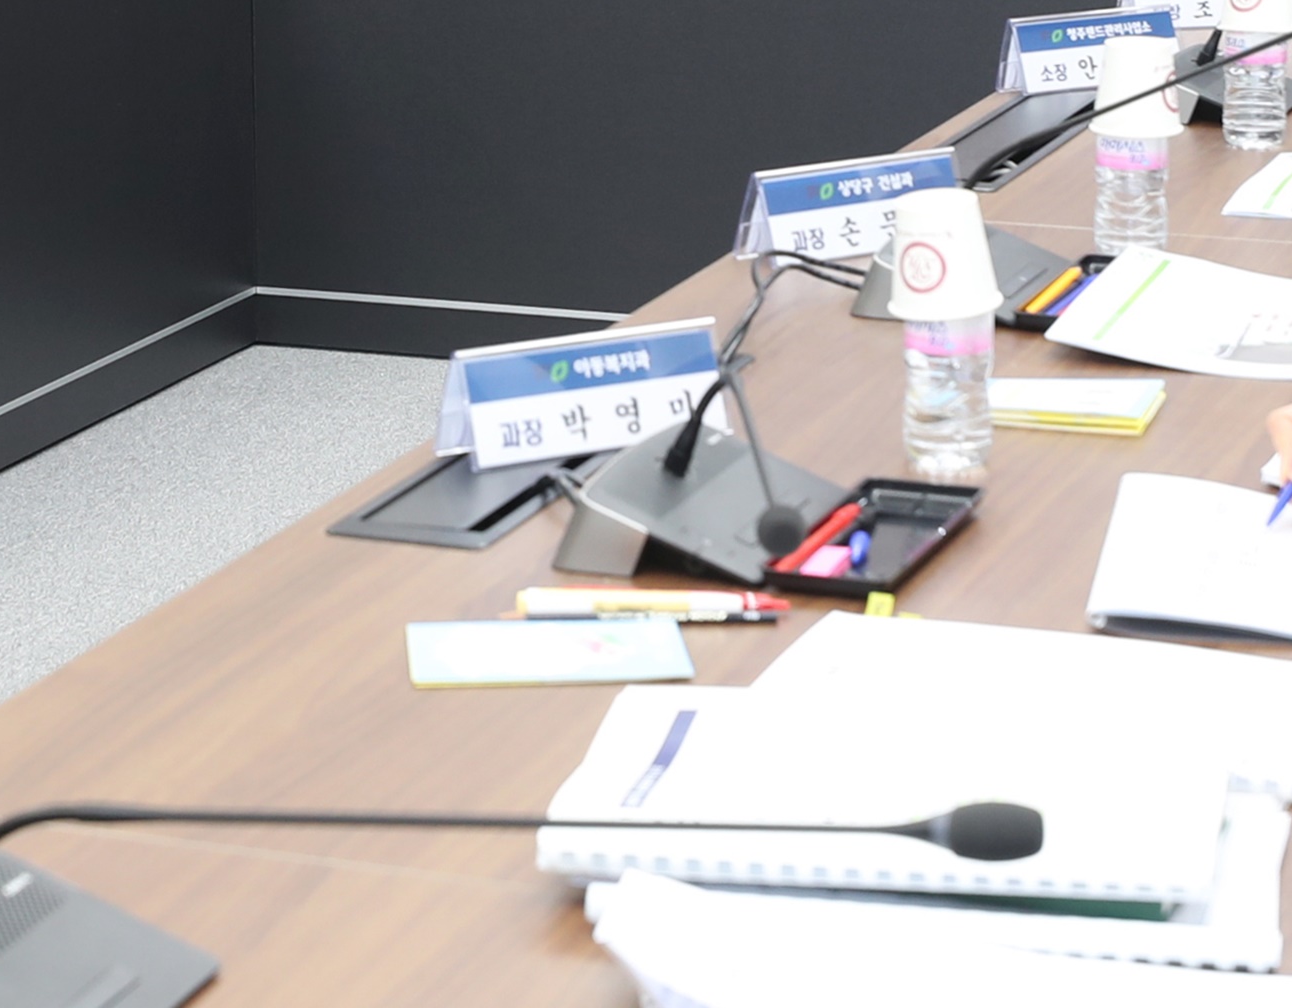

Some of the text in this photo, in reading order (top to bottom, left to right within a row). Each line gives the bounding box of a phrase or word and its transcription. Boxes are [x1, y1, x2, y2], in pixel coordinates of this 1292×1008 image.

[1193, 0, 1214, 19] 조
[1040, 55, 1098, 83] 소장 안
[791, 227, 825, 253] 과장
[839, 215, 861, 247] 손
[499, 417, 543, 448] 과장
[561, 403, 591, 441] 박
[615, 396, 641, 434] 영
